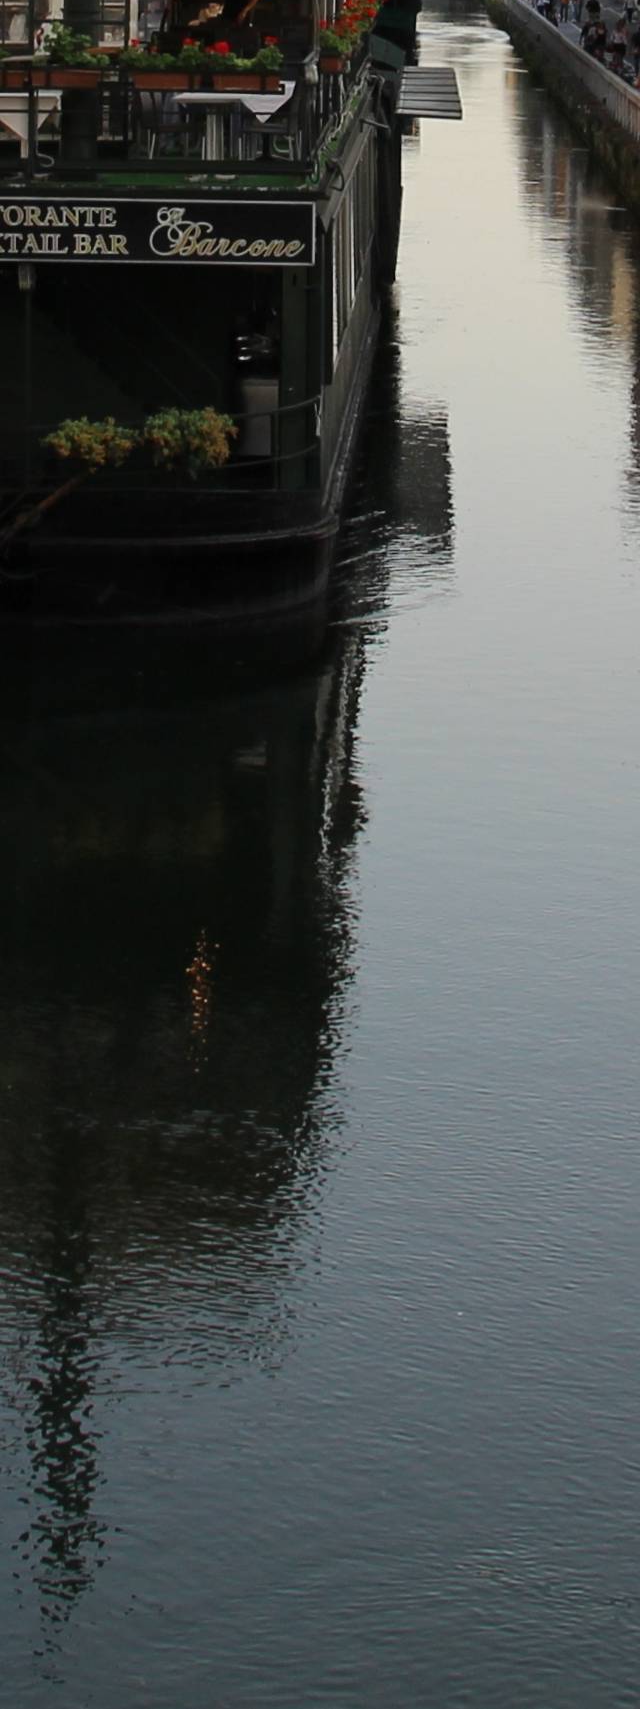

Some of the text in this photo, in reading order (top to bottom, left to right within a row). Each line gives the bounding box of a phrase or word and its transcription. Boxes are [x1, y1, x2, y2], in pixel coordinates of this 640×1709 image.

[0, 205, 117, 227] ORANTE
[0, 233, 129, 254] TAIL BAR
[150, 220, 304, 257] Barcone
